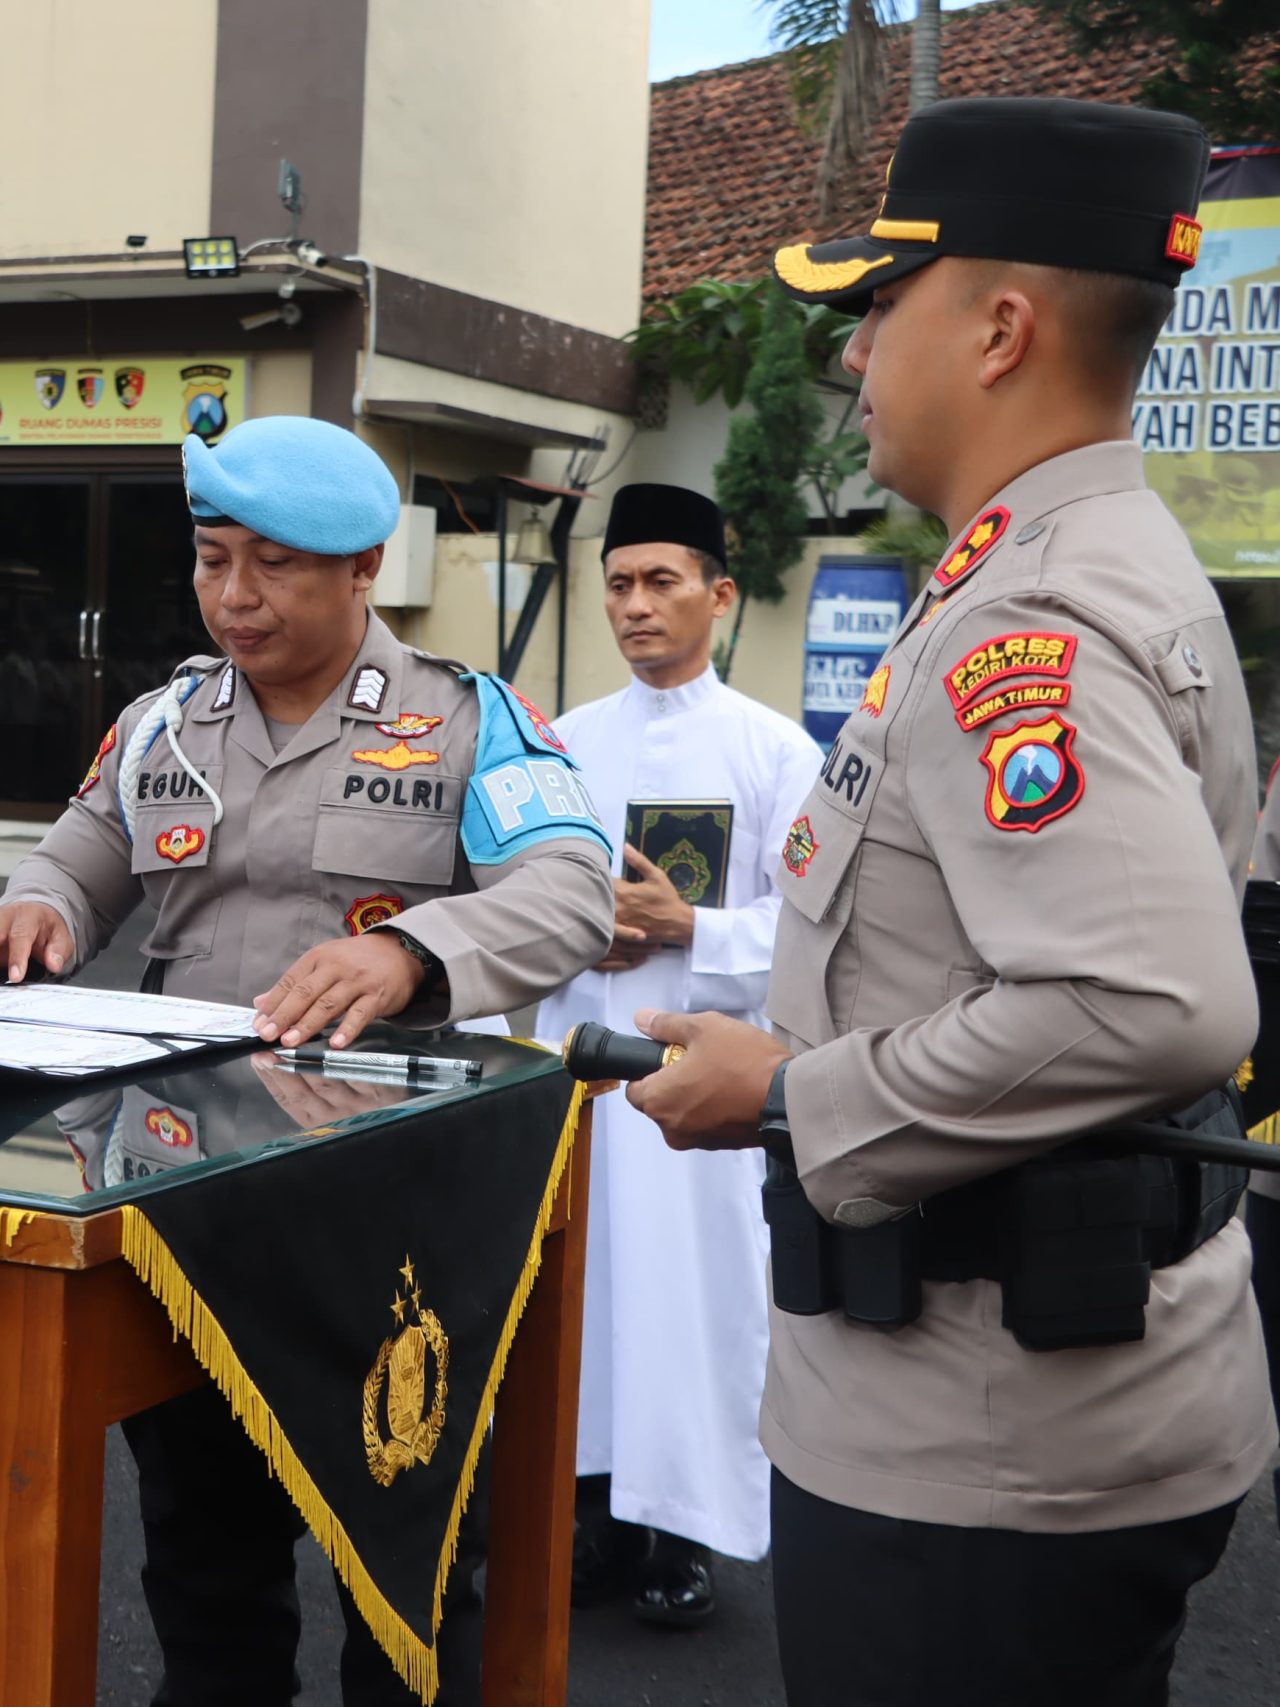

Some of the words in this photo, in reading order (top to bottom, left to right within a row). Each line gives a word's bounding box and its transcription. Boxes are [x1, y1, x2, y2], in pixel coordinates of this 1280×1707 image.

[1167, 288, 1231, 332] DA
[1216, 345, 1280, 390] INT
[19, 418, 62, 429] RUANG
[66, 418, 111, 429] DUMAS
[115, 418, 163, 428] PRESISI
[833, 611, 894, 633] DLHKP
[951, 637, 1066, 689] POLRES
[957, 659, 1006, 699] KEDIRI
[1011, 653, 1059, 669] KOTA
[964, 696, 1006, 725] JAWA
[1007, 687, 1064, 703] TIMUR
[343, 774, 443, 810] POLRI
